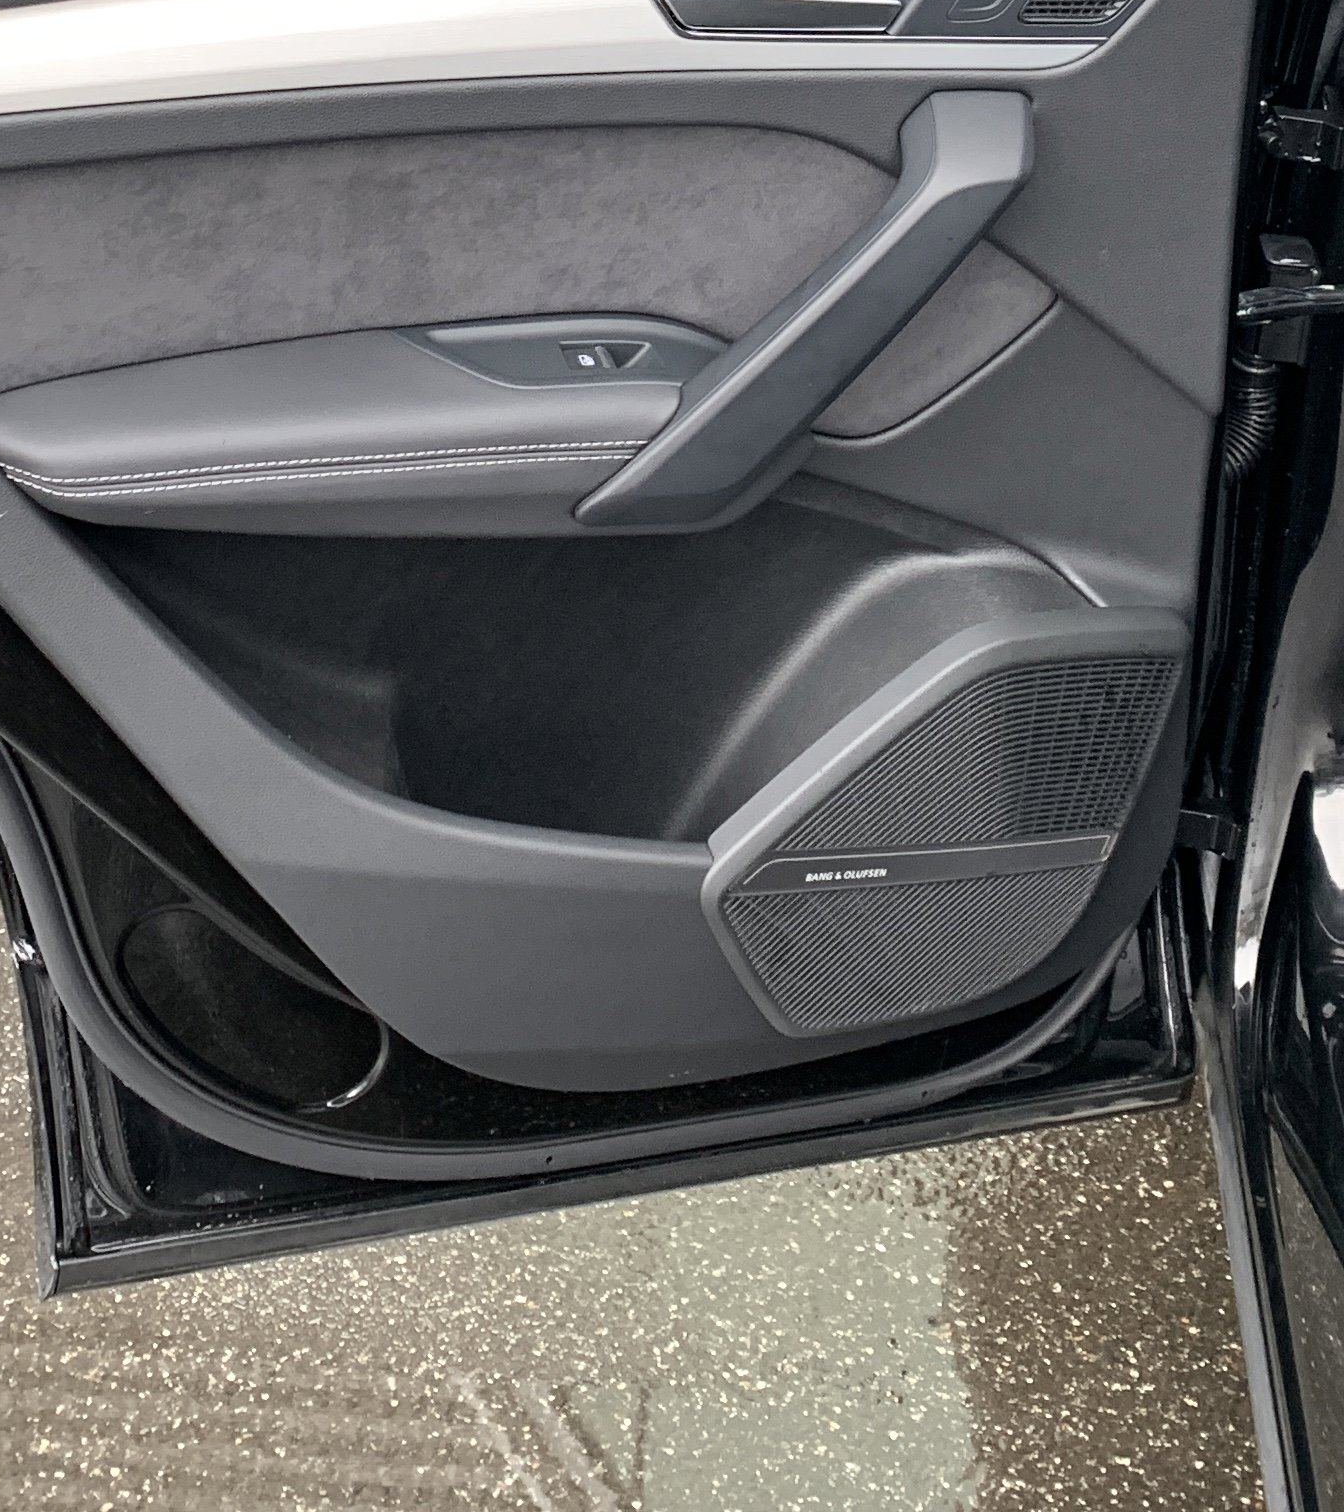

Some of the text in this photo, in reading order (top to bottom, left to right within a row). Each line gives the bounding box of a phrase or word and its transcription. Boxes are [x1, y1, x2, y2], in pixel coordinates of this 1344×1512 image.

[805, 868, 888, 882] BANG & OLUFSEN
